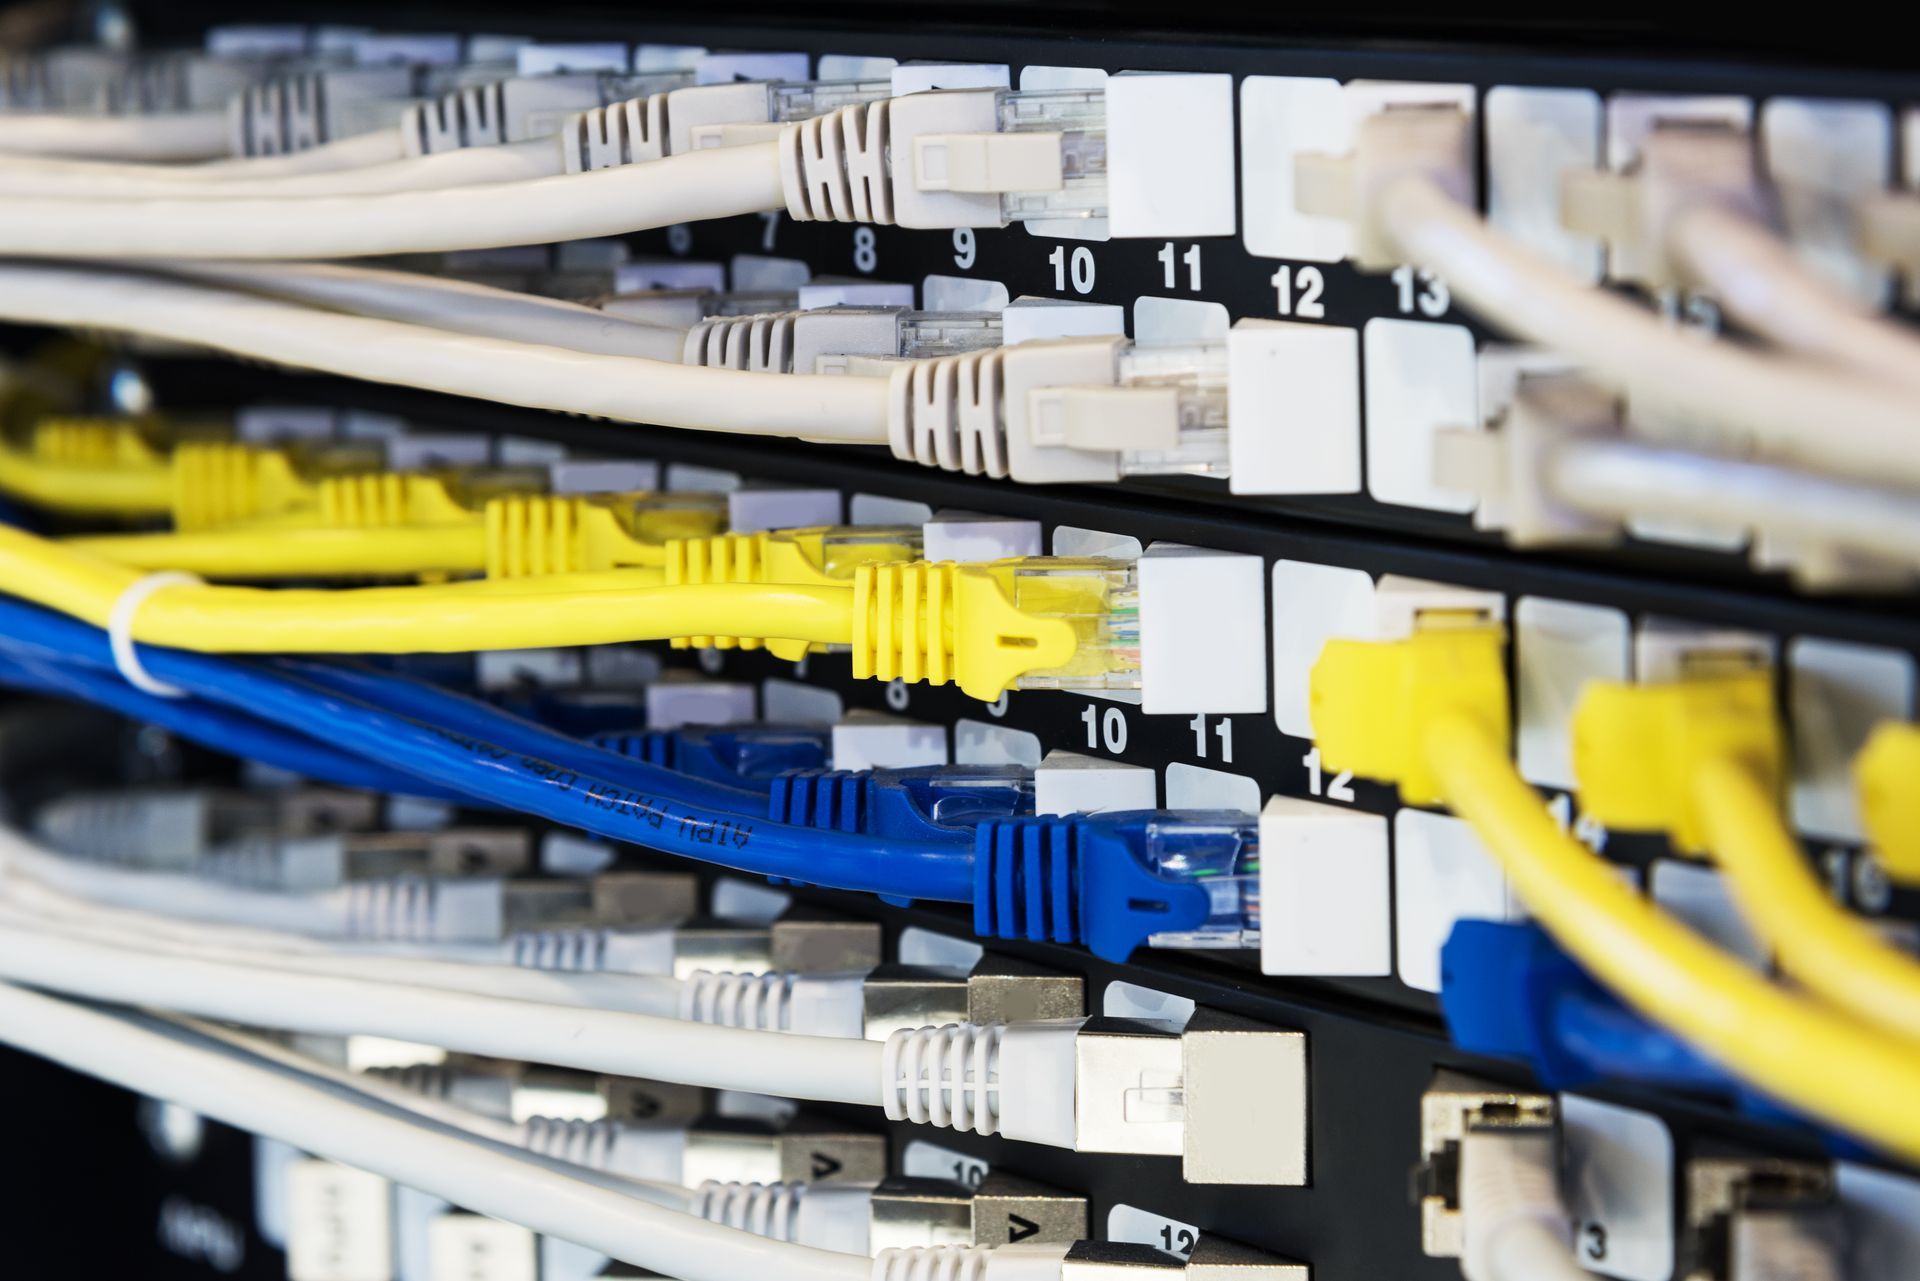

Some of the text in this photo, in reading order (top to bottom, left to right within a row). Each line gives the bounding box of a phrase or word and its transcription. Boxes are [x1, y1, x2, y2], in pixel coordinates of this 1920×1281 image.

[853, 226, 878, 275] 8
[952, 227, 977, 270] 9
[1048, 244, 1097, 295] 10
[1157, 241, 1202, 292] 11
[1270, 264, 1325, 319] 12
[1391, 263, 1451, 319] 13
[1080, 703, 1129, 755] 10
[1190, 713, 1234, 764] 11
[1301, 748, 1356, 803] 12
[584, 781, 669, 830] PATCH
[678, 814, 753, 850] AIPU
[1160, 1224, 1196, 1256] 12
